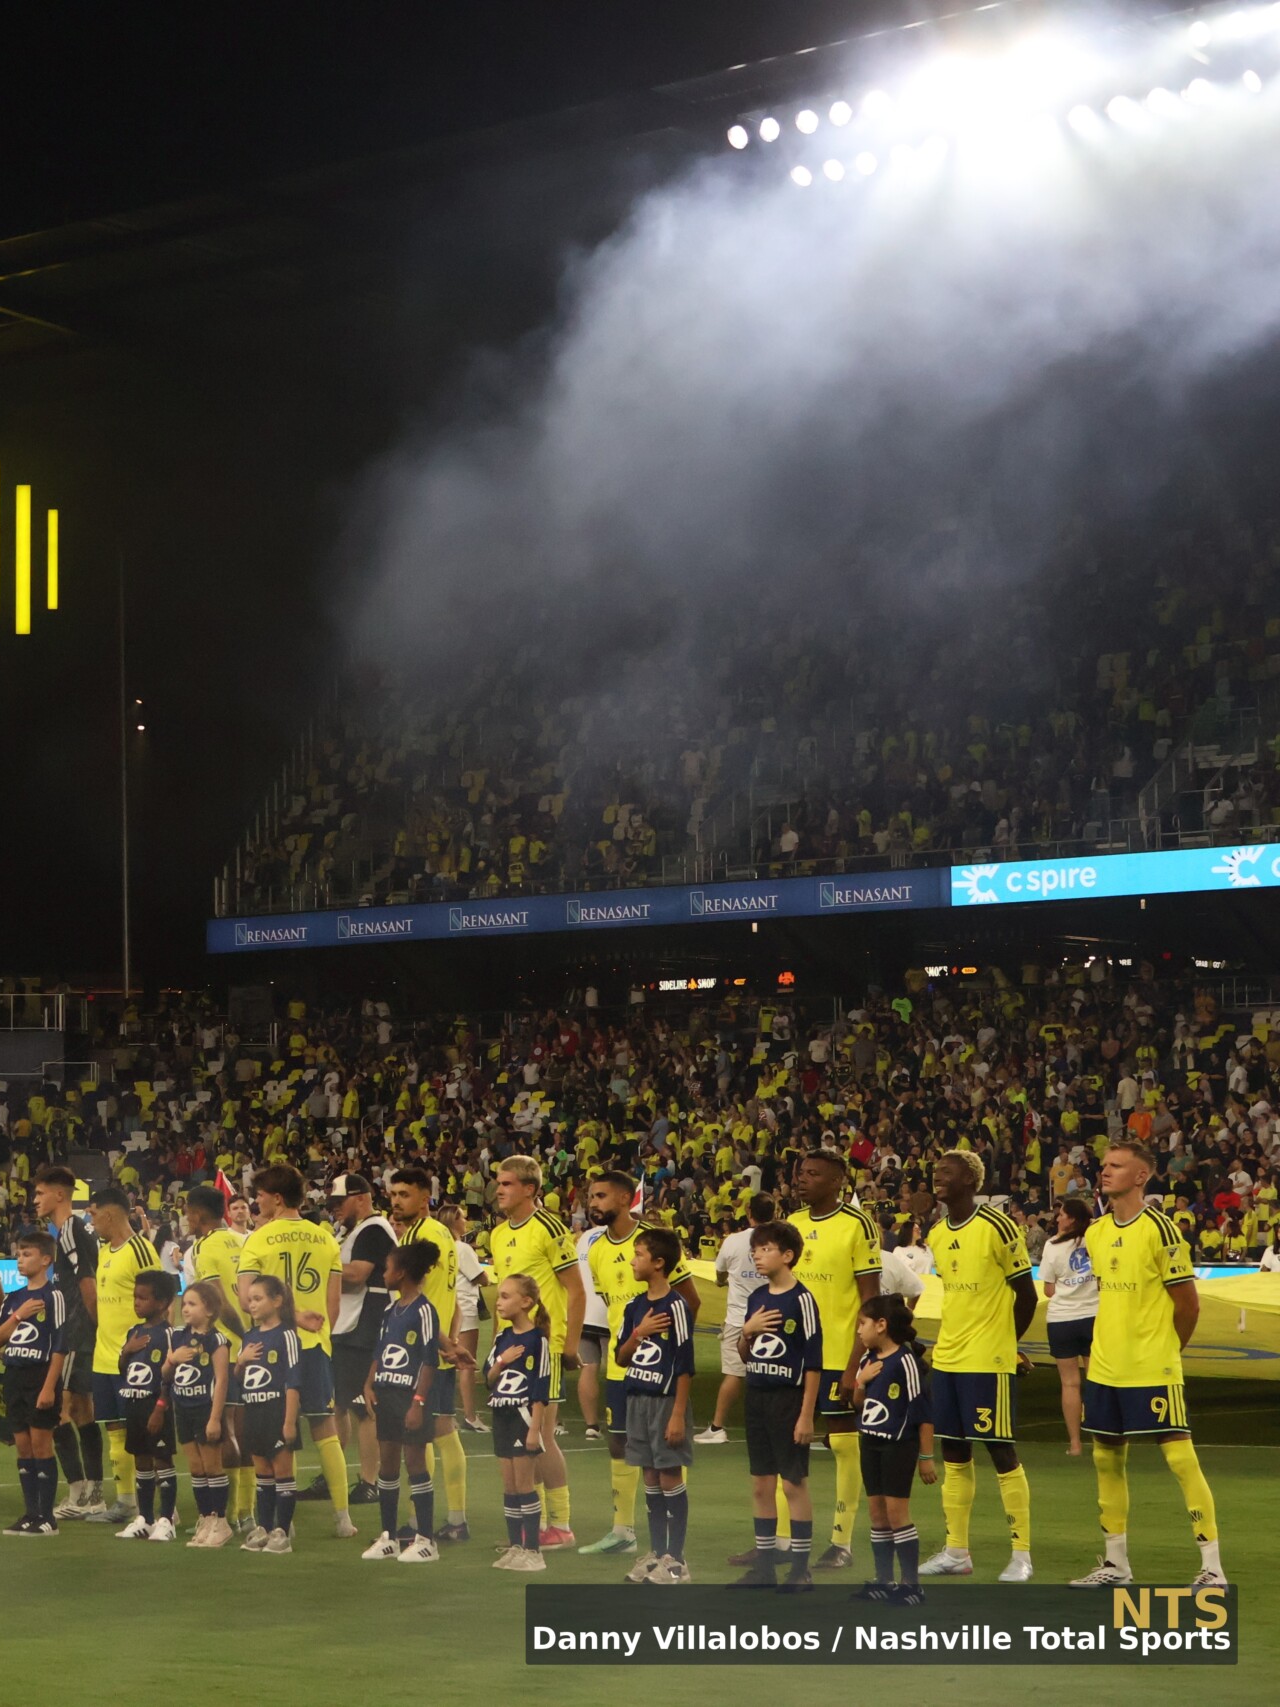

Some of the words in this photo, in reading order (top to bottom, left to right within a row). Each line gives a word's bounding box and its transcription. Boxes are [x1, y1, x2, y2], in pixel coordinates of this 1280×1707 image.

[1026, 866, 1097, 896] spire
[704, 895, 778, 912] RENASANT
[835, 886, 913, 904] RENASANT
[462, 911, 528, 928] RENASANT
[580, 904, 651, 921] RENASANT
[247, 927, 308, 943] RENASANT
[350, 919, 413, 936] RENASANT
[659, 979, 688, 991] SIDELINE
[267, 1231, 326, 1246] CORCORAN
[279, 1251, 321, 1294] 16
[1150, 1396, 1168, 1423] 9
[974, 1407, 993, 1433] 3
